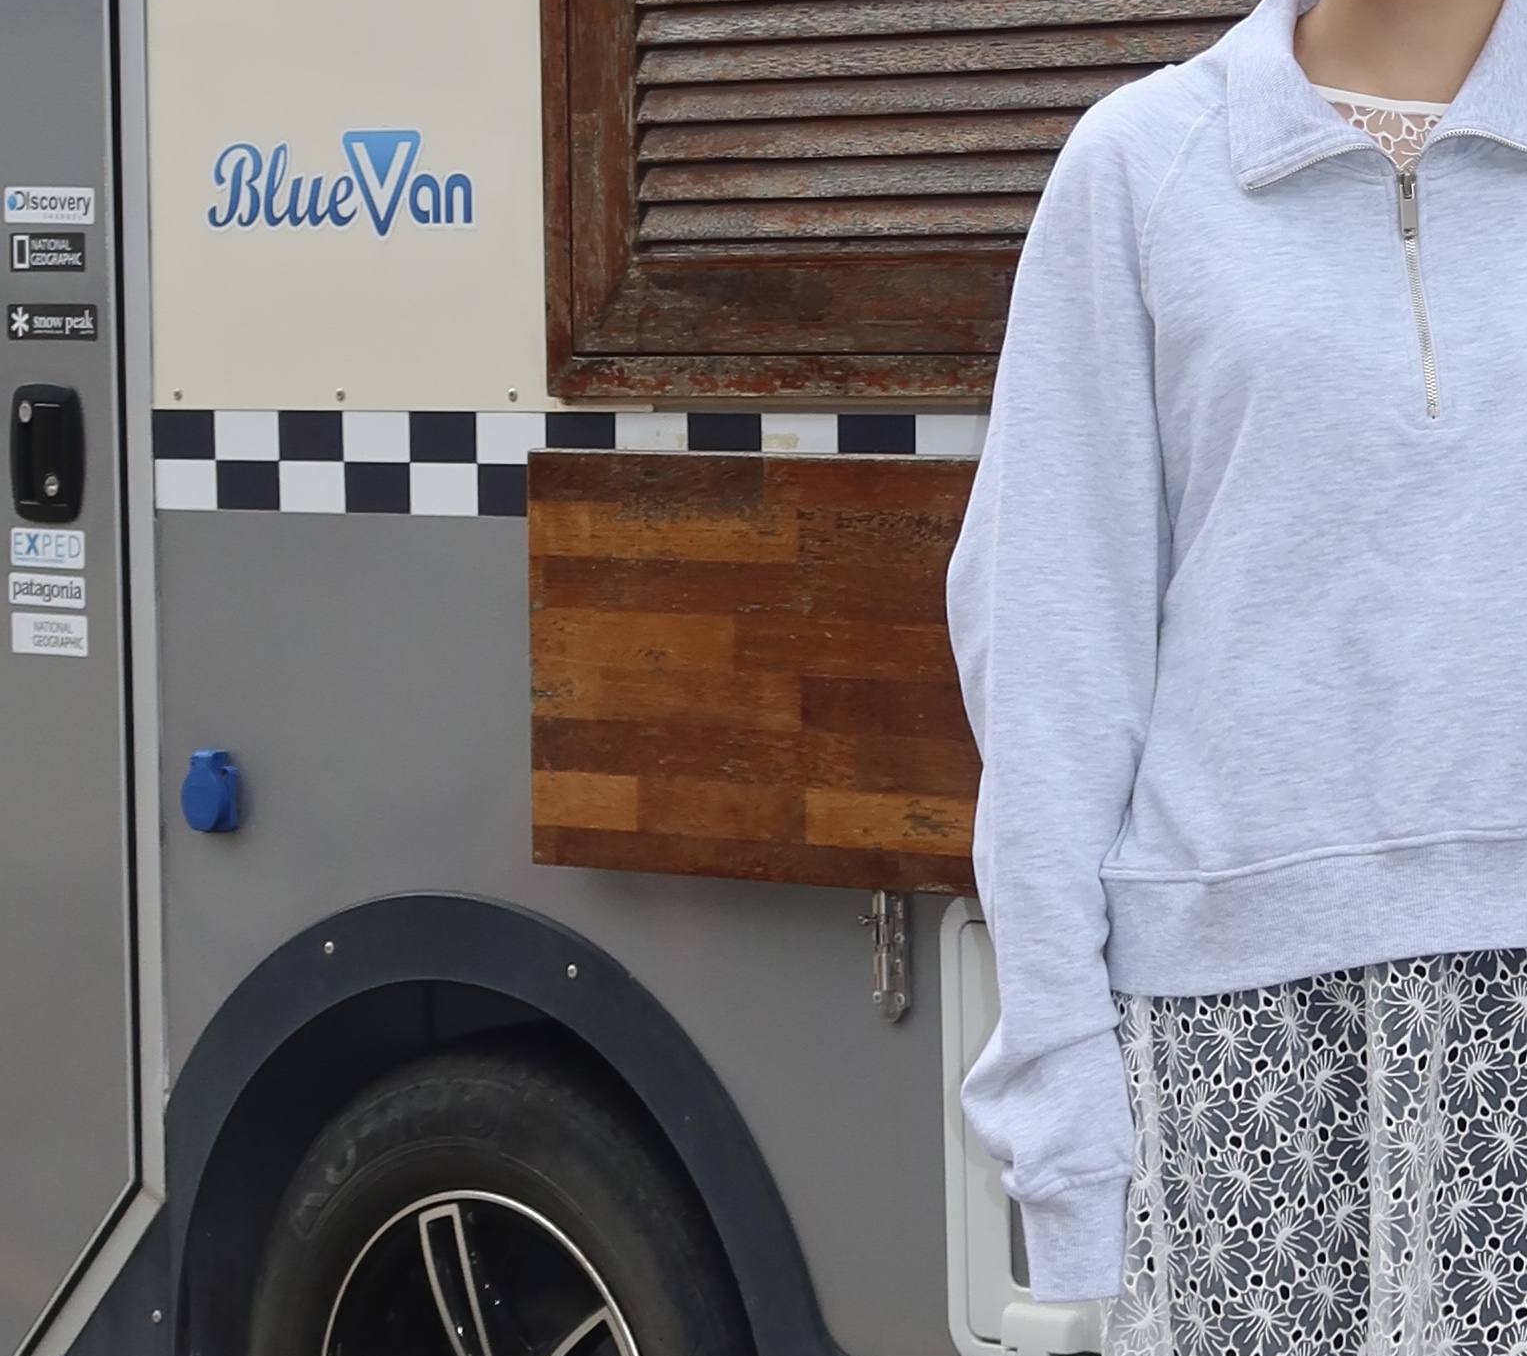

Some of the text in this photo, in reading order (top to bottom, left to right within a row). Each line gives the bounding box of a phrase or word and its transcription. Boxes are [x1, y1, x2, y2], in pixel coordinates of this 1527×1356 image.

[31, 239, 72, 251] NATIONAL
[31, 252, 82, 265] GEOGRAPHIC
[32, 310, 94, 335] snow peak
[13, 533, 82, 558] EXPED
[12, 580, 82, 603] patagonia
[33, 622, 73, 634] NATIONAL
[32, 635, 84, 650] GEOGRAPHIC
